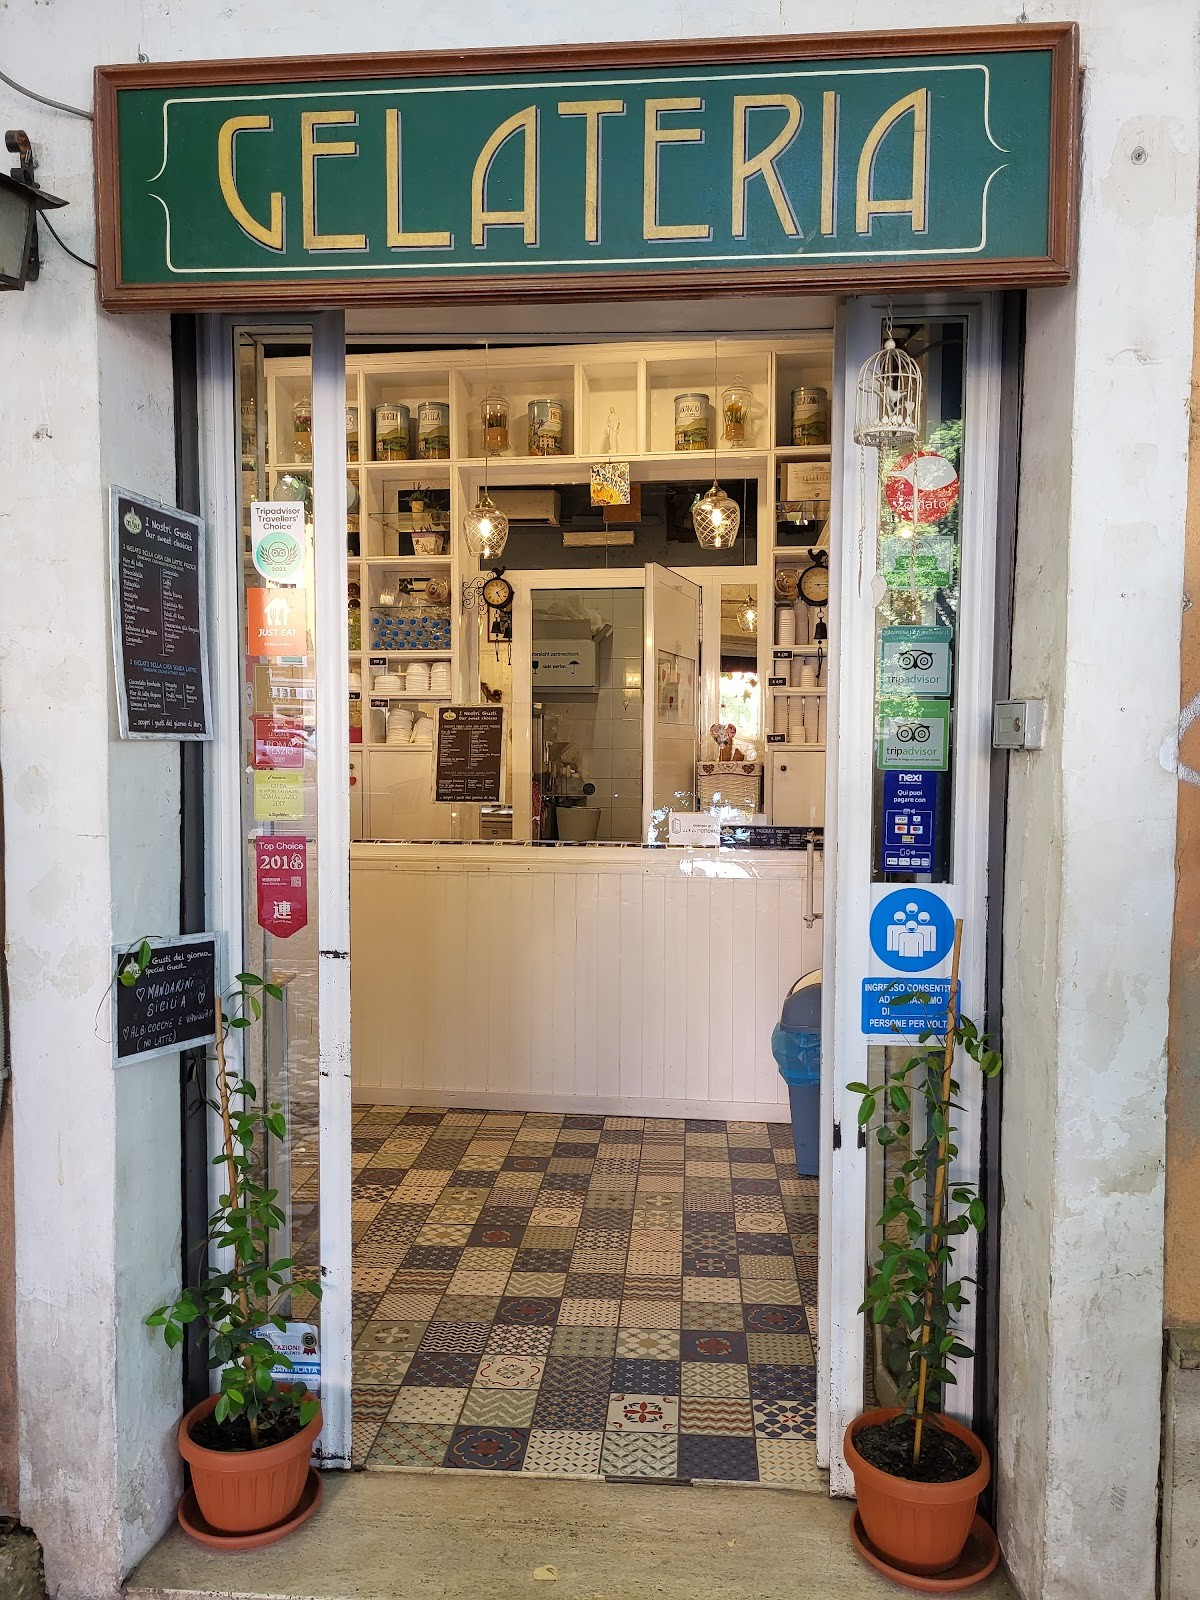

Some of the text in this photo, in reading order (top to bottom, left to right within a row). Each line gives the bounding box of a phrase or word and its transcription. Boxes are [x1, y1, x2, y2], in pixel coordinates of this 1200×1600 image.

[217, 87, 932, 253] GELATERIA
[255, 507, 301, 517] Tripadvisor
[258, 515, 299, 523] Travellers'
[151, 519, 172, 534] Nostri
[173, 527, 193, 541] Gusti
[263, 522, 292, 530] Choice
[145, 529, 156, 540] Our
[173, 539, 193, 552] choices
[258, 628, 298, 638] JUST EAT
[887, 674, 941, 685] tripadvisor
[886, 746, 938, 758] tripadvisor
[898, 773, 922, 782] nexi
[897, 789, 923, 797] Qui puoi
[259, 841, 304, 852] Top Choice
[260, 853, 304, 870] 2018
[152, 955, 171, 965] Gusti
[173, 952, 185, 962] del
[145, 966, 165, 978] Special
[878, 995, 889, 1004] AD
[881, 1007, 889, 1016] DI
[178, 1016, 183, 1025] E
[869, 1019, 948, 1029] PERSONE PER VOLT
